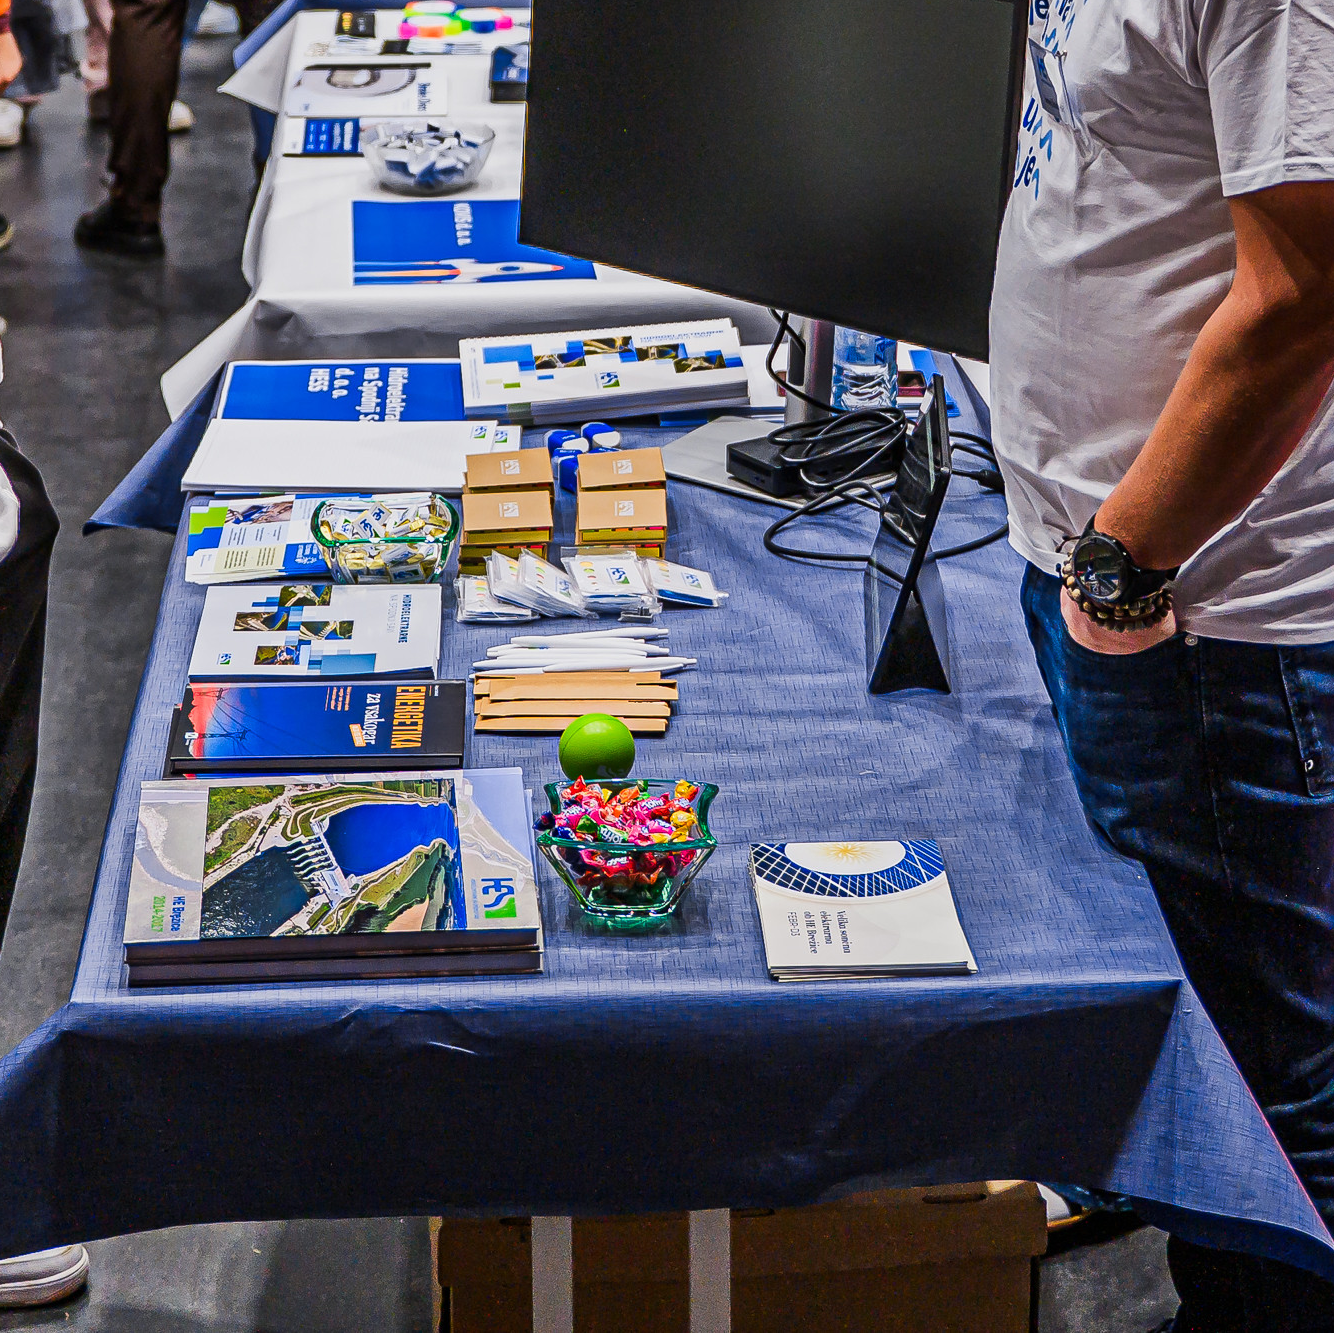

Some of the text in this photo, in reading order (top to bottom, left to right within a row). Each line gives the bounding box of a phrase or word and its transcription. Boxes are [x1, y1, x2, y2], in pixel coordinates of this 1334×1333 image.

[307, 368, 331, 393] HESS
[364, 367, 380, 380] na
[355, 380, 383, 413] Spodnji
[384, 367, 409, 422] Hidroelektra
[361, 693, 386, 745] za vsakogar
[390, 686, 427, 749] ENERGETIKA
[172, 895, 186, 905] HE
[820, 910, 833, 944] elektrarna
[836, 910, 849, 929] Velika
